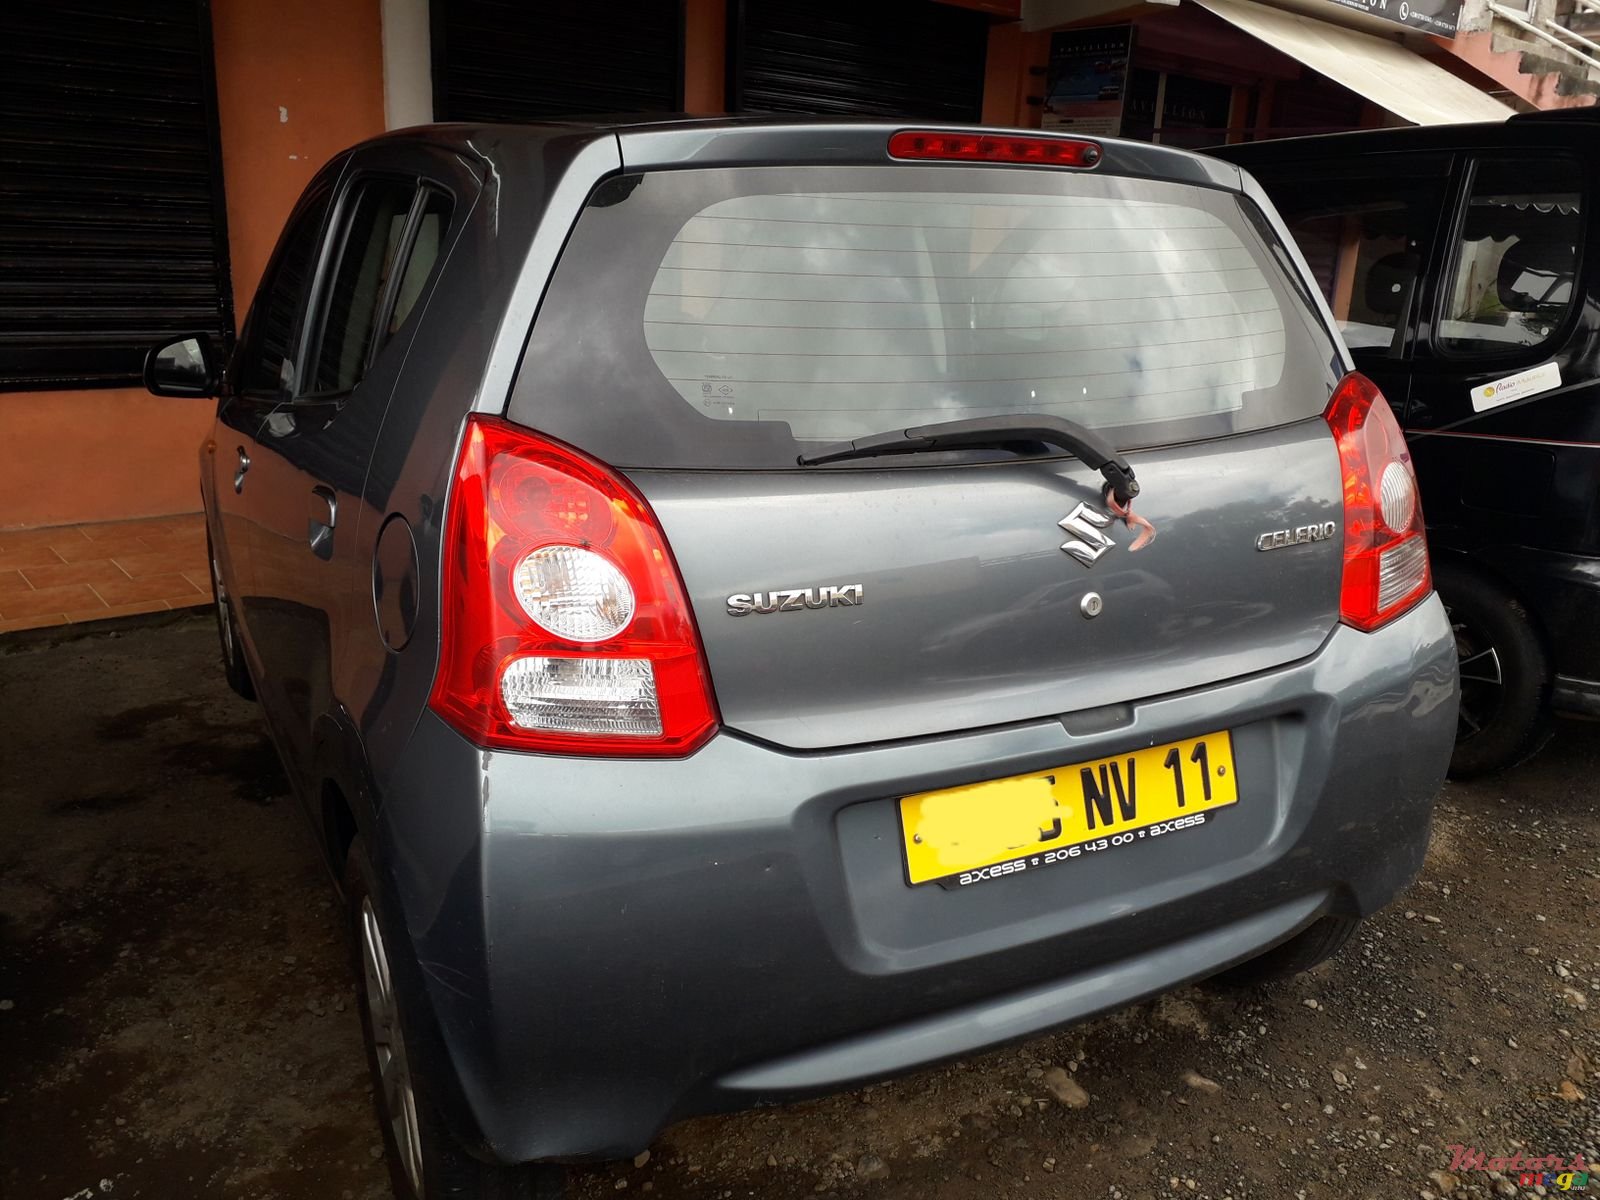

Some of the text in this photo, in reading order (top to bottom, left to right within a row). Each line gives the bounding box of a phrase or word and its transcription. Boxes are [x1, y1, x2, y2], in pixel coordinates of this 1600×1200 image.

[1255, 521, 1336, 552] CELERIO
[726, 584, 865, 616] SUZUKI
[1080, 758, 1136, 830] NV
[1164, 742, 1212, 808] 11
[959, 813, 1206, 886] axess 206 43 00 axess
